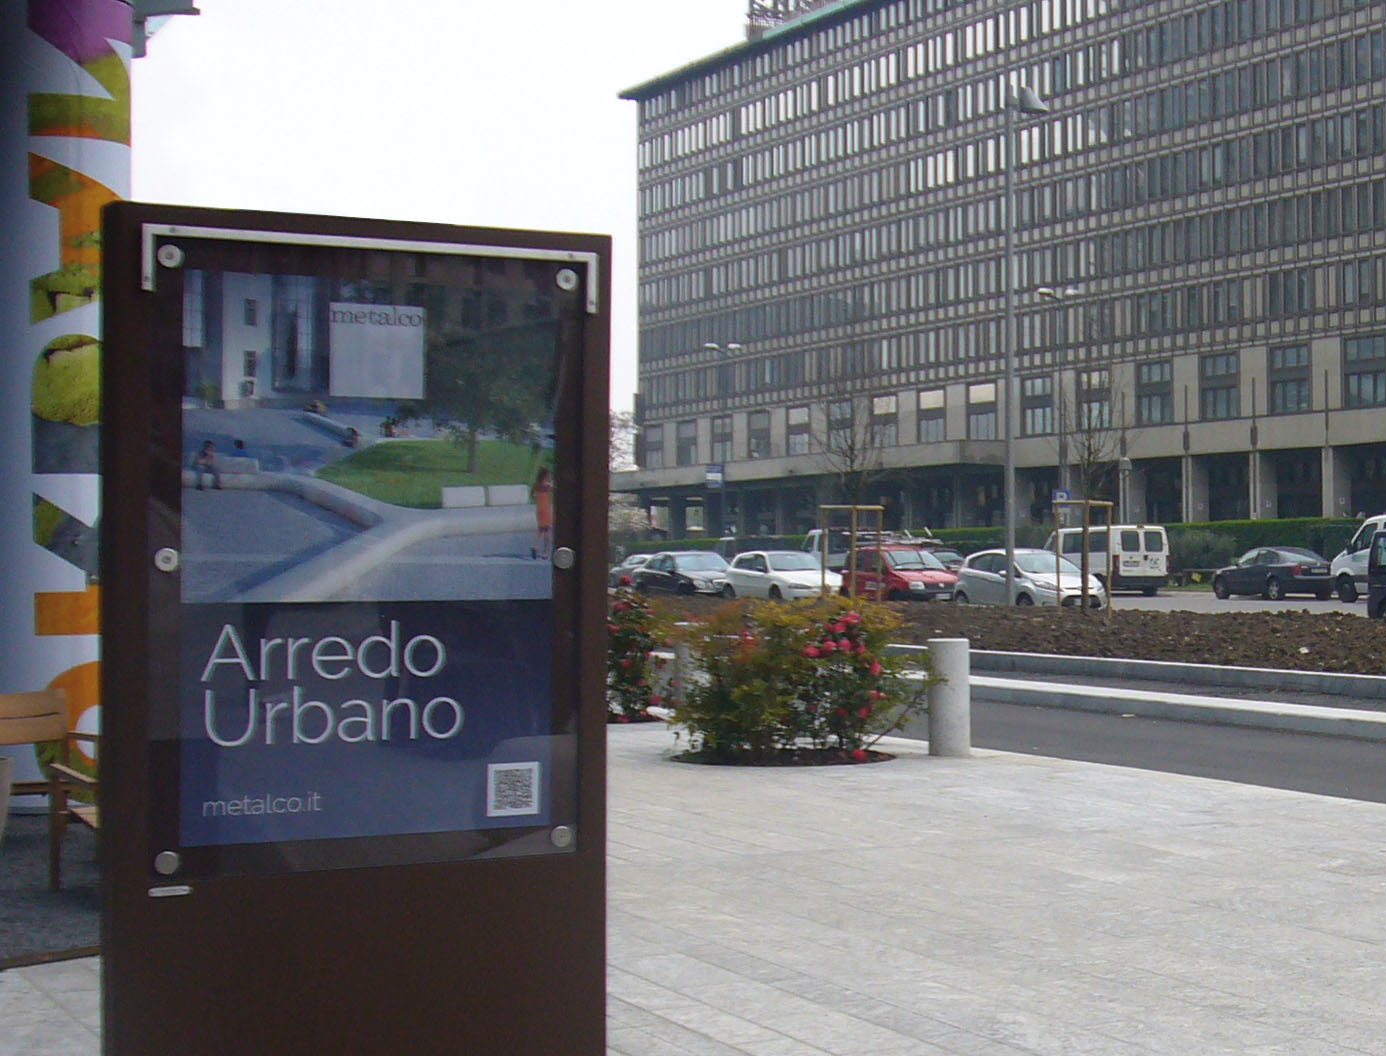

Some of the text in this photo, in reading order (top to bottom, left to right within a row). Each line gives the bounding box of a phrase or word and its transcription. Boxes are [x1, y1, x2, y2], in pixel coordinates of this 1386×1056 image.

[330, 305, 422, 328] metalco
[200, 619, 447, 682] Arredo
[204, 685, 464, 748] Urbano
[202, 791, 322, 817] metalco.it
